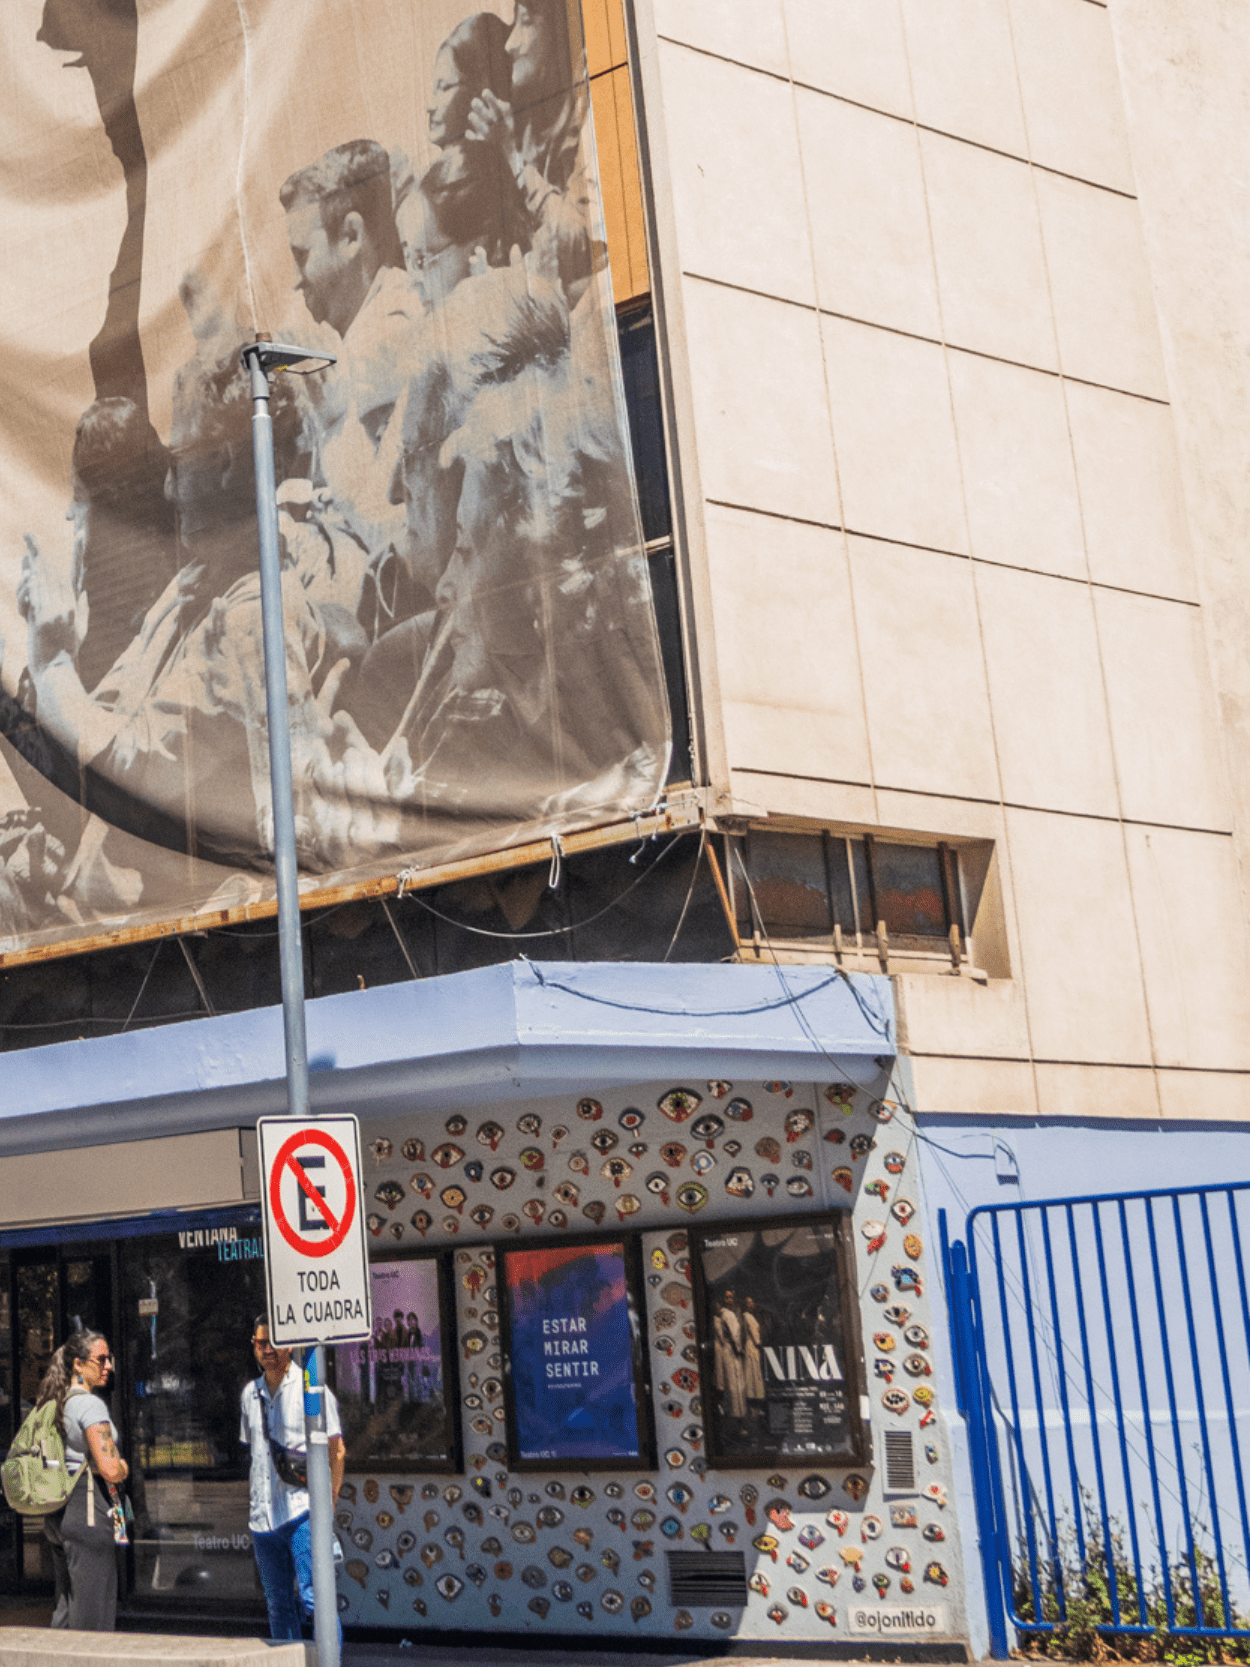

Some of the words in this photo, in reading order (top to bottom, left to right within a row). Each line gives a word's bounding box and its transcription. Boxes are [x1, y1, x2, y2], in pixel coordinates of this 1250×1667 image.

[178, 1227, 238, 1249] VENTANA
[217, 1237, 264, 1261] TEATRAL
[297, 1270, 340, 1292] TODA
[276, 1304, 296, 1326] LA
[303, 1299, 363, 1323] CUADRA
[542, 1317, 587, 1334] ESTAR
[544, 1339, 589, 1356] MIRAR
[545, 1361, 599, 1378] SENTIR
[191, 1534, 230, 1549] Teatro
[231, 1534, 250, 1549] UC
